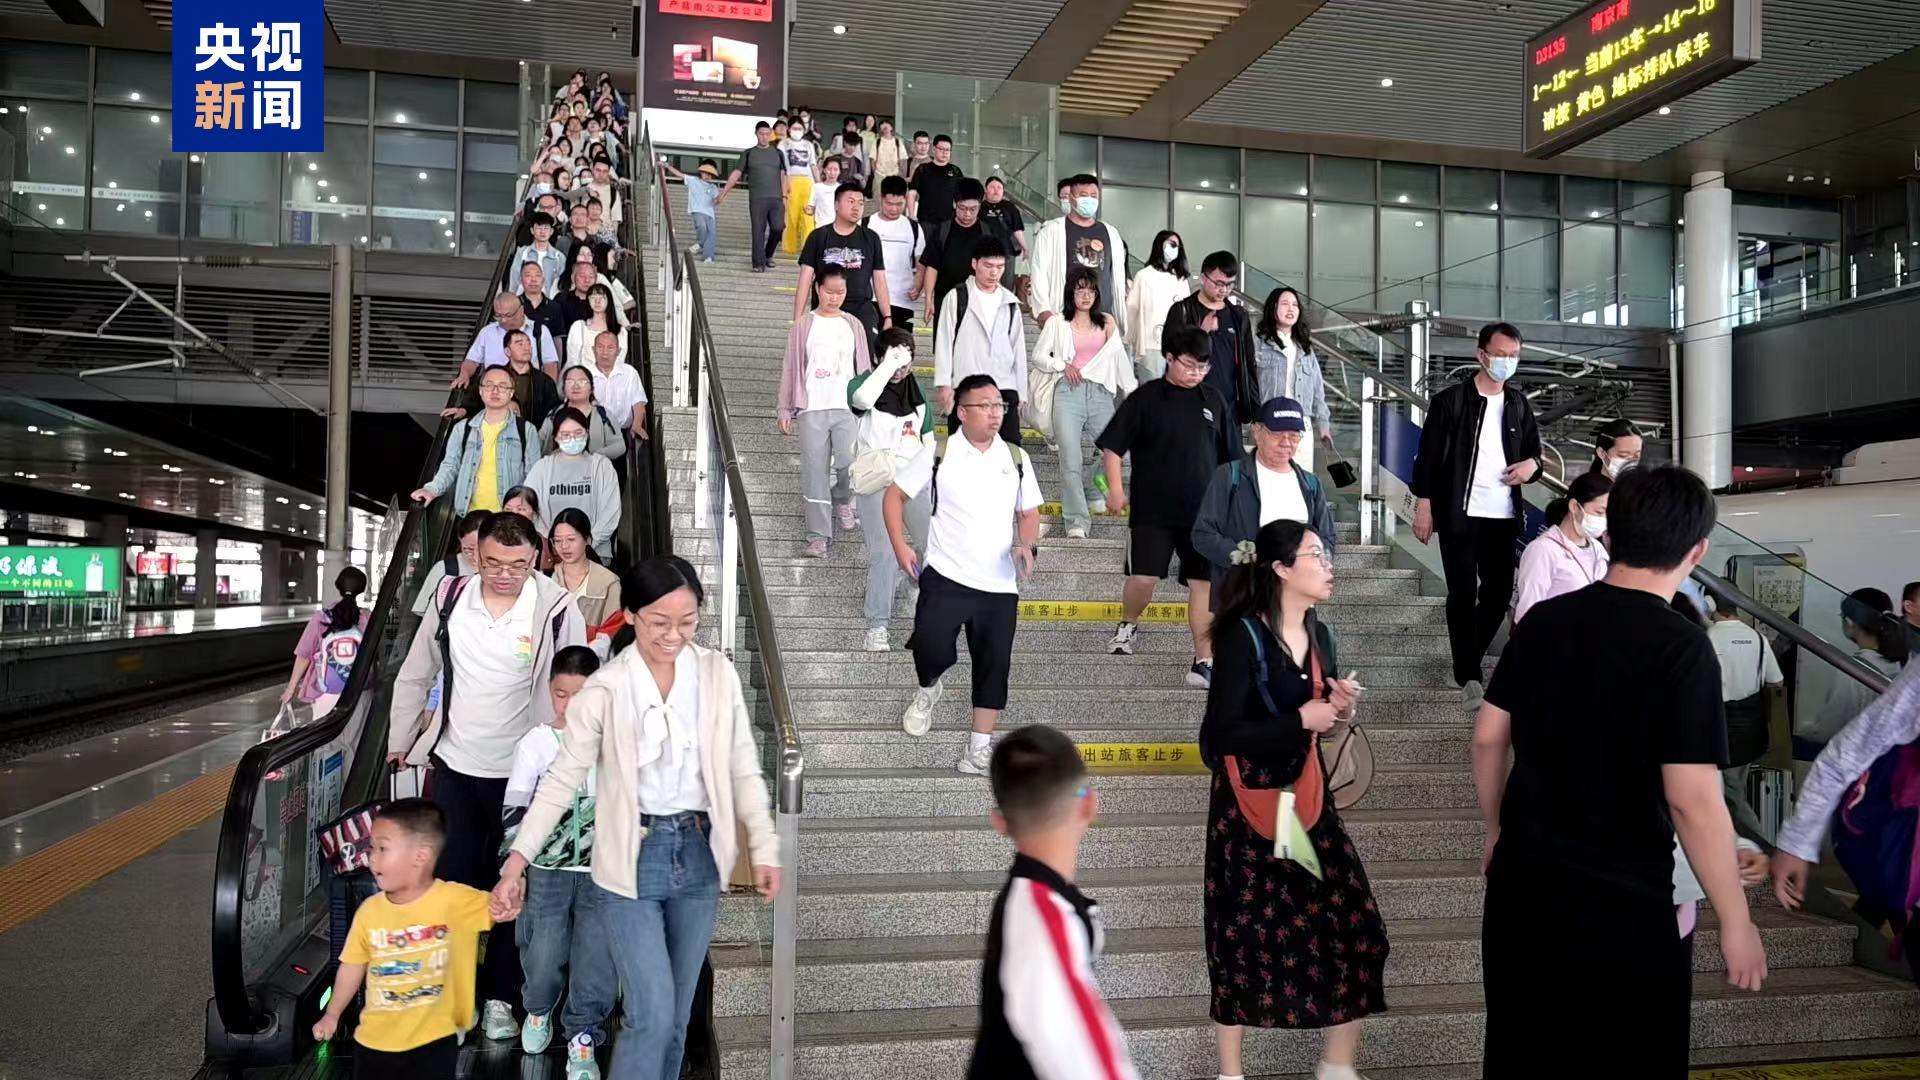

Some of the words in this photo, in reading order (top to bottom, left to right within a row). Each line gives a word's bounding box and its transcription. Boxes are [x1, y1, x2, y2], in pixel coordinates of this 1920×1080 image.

[1535, 36, 1567, 66] D3135
[1017, 604, 1080, 617] 旅客止步
[1083, 747, 1185, 763] 出站旅客止步
